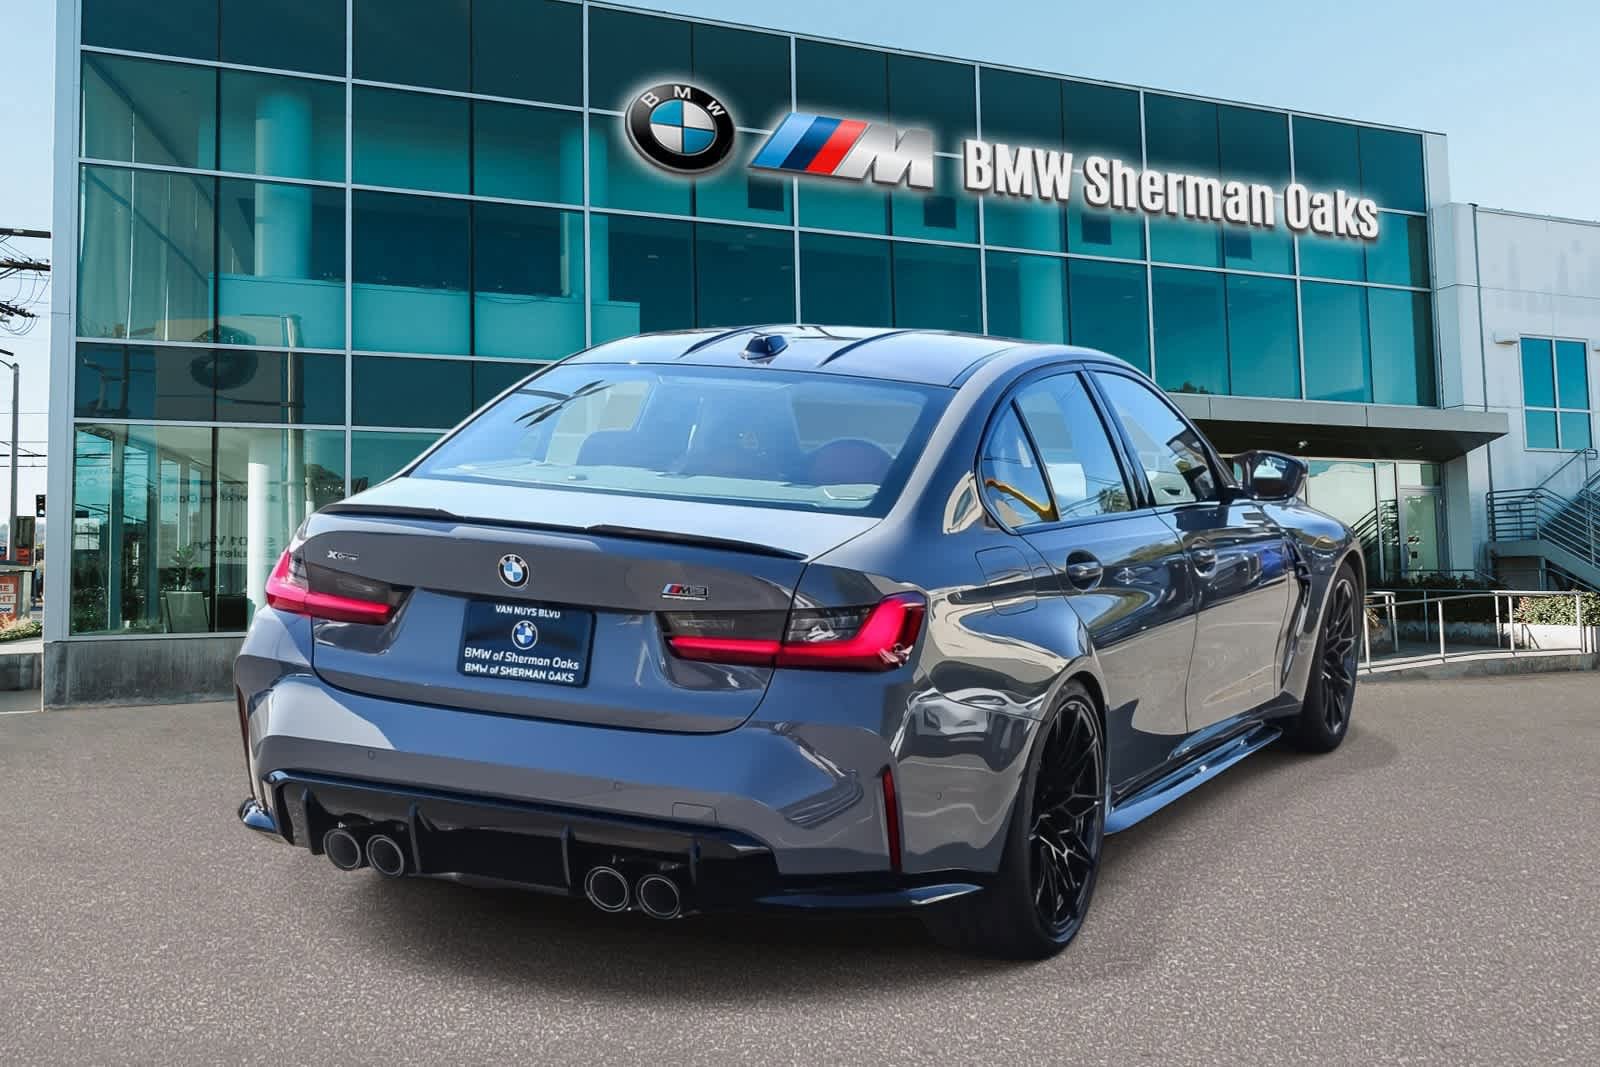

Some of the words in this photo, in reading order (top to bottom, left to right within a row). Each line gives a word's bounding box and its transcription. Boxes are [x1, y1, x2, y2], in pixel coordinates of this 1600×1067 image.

[641, 85, 725, 117] BMW
[964, 139, 1073, 201] BMW
[1083, 155, 1275, 228] Sherman
[1283, 182, 1379, 240] Oaks
[495, 604, 513, 614] VAN
[514, 606, 537, 617] NUYS
[538, 609, 561, 619] BLVD
[464, 647, 491, 660] BMW
[493, 650, 504, 661] of
[505, 651, 551, 667] Sherman
[552, 656, 580, 671] Oaks
[464, 662, 488, 674] BMW
[489, 664, 499, 675] of
[500, 665, 546, 680] SHERMAN
[548, 671, 575, 683] OAKS
